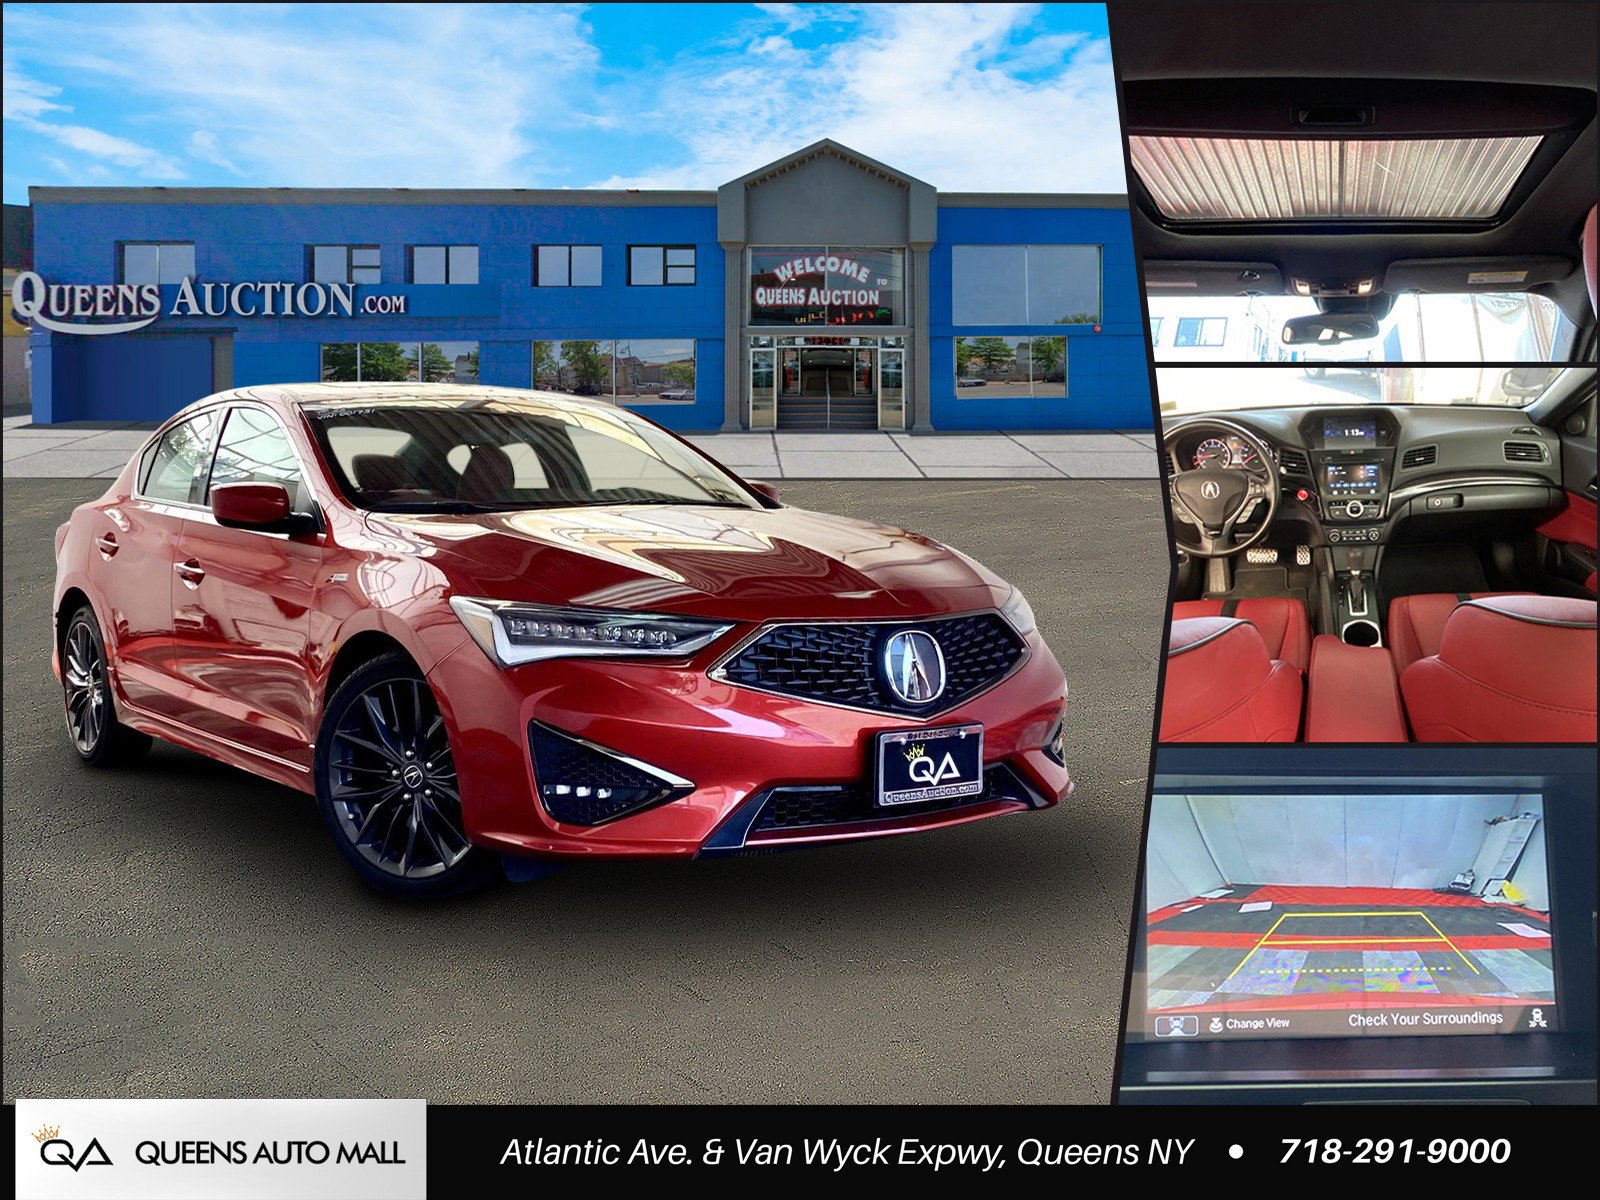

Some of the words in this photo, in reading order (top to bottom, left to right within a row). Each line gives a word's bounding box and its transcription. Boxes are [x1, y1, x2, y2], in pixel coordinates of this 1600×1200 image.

[774, 256, 872, 284] WELCOME
[876, 278, 888, 286] TO
[12, 271, 161, 335] QUEENS
[755, 287, 806, 306] QUEENS
[808, 287, 880, 306] AUCTION
[885, 783, 979, 803] QueensAuction.com
[1226, 1018, 1265, 1030] Change
[1266, 1017, 1290, 1028] View
[1348, 1013, 1388, 1027] Check
[1391, 1012, 1420, 1026] Your
[1423, 1012, 1503, 1025] Surroundings
